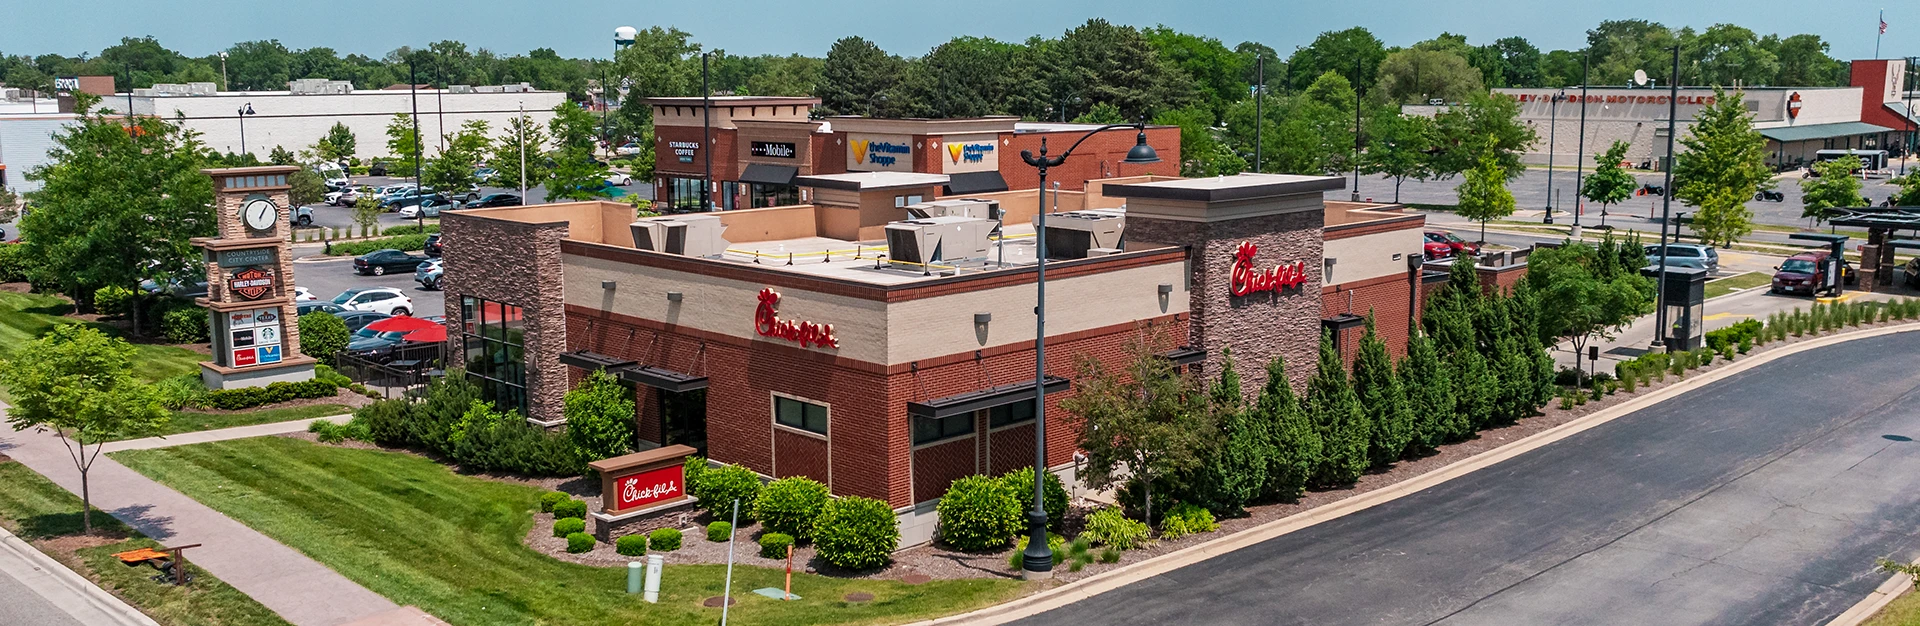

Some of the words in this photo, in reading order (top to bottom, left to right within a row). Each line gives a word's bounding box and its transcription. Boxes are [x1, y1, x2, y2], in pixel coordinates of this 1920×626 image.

[669, 141, 699, 149] STARBUCKS
[675, 148, 694, 156] COFFEE
[869, 154, 895, 166] Shoppe
[226, 249, 270, 257] COUNTRYSIDE
[244, 255, 269, 263] CENTER
[233, 279, 271, 288] HARLEY-DAVIDSON
